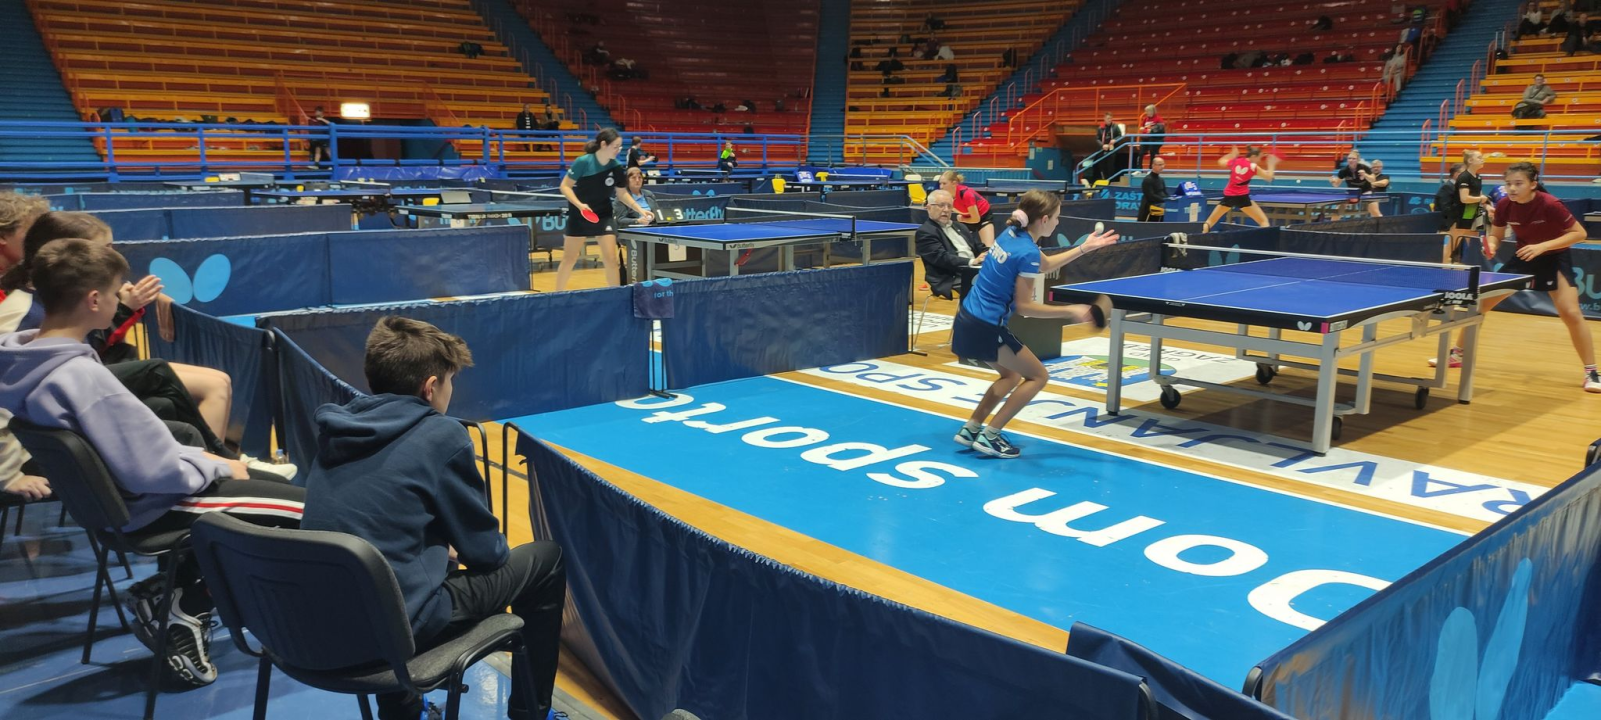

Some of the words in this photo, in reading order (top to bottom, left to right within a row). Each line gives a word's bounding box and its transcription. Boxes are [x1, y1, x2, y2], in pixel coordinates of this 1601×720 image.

[657, 209, 664, 220] 1
[674, 208, 683, 219] 3
[683, 205, 724, 220] tterfly
[1444, 291, 1474, 300] JOOLA
[614, 392, 980, 490] sporta
[982, 487, 1397, 632] Dom
